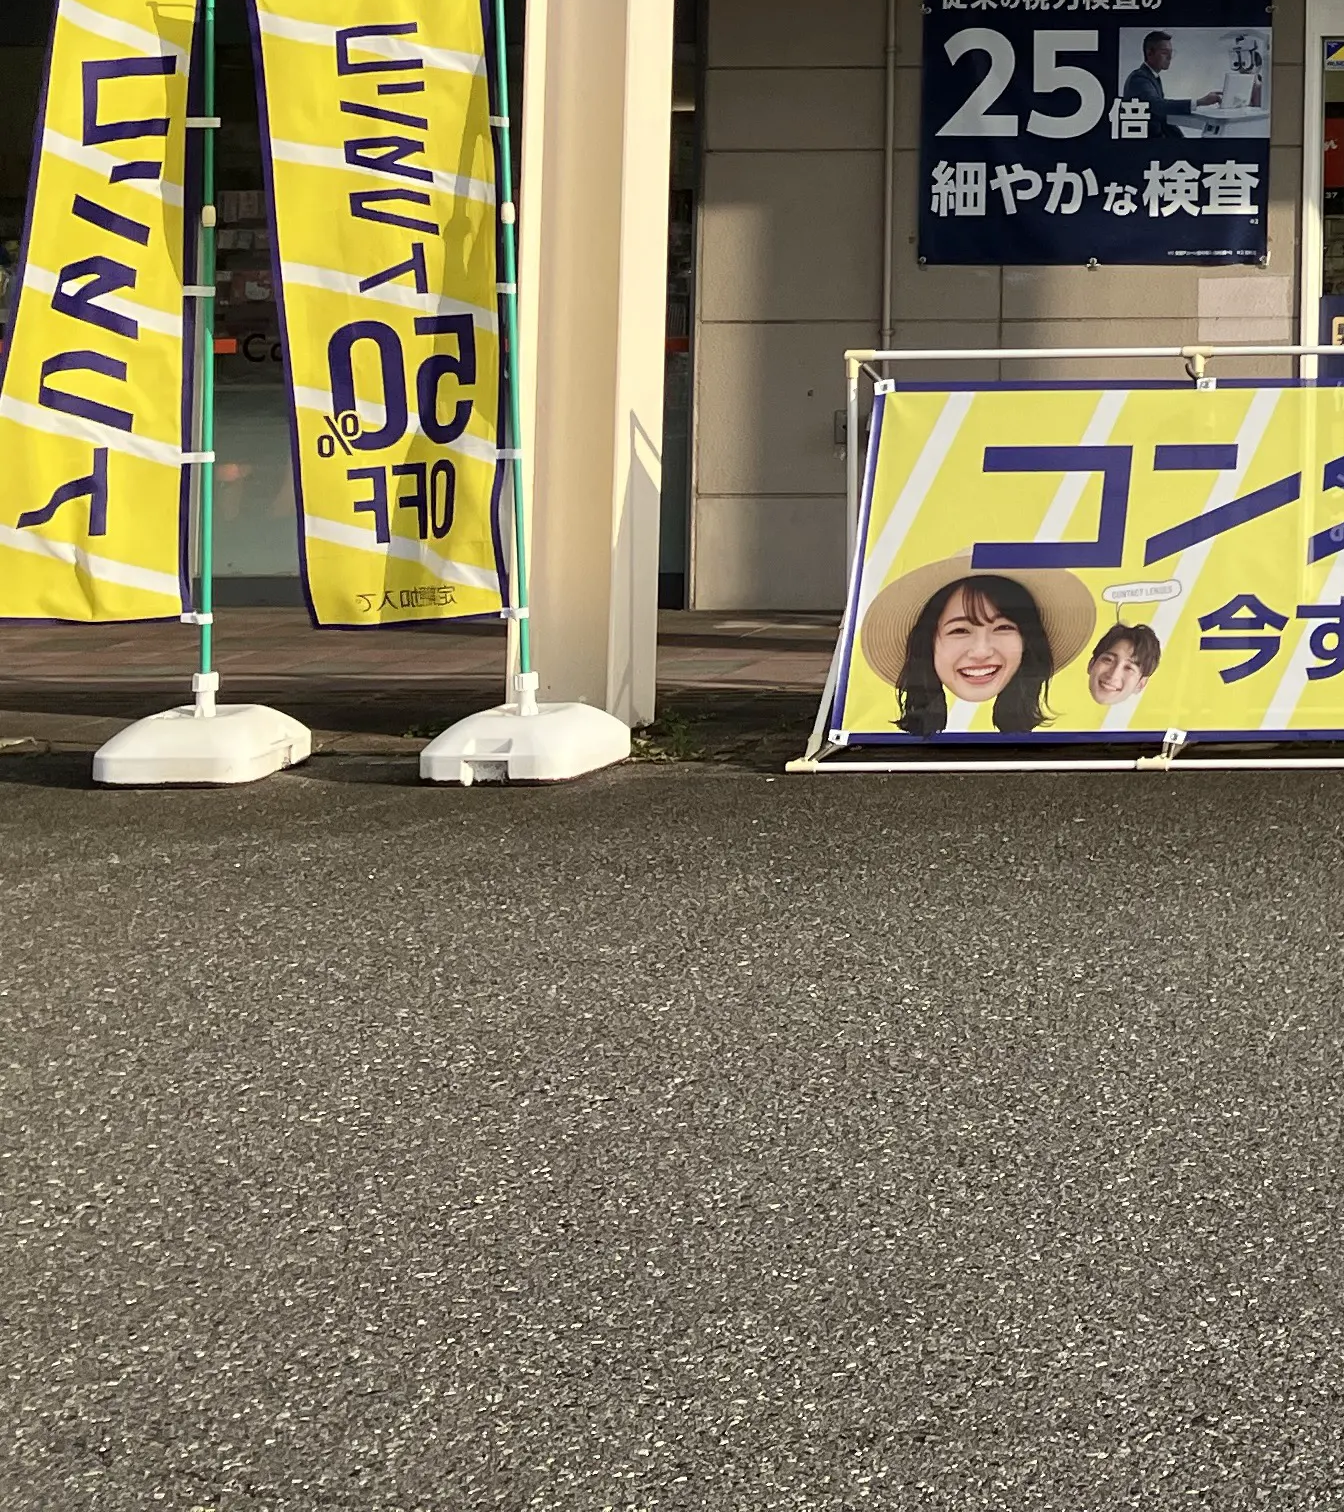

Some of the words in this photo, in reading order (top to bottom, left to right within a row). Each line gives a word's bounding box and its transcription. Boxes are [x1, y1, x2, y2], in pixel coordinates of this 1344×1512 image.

[930, 160, 1260, 219] 細やかな検査
